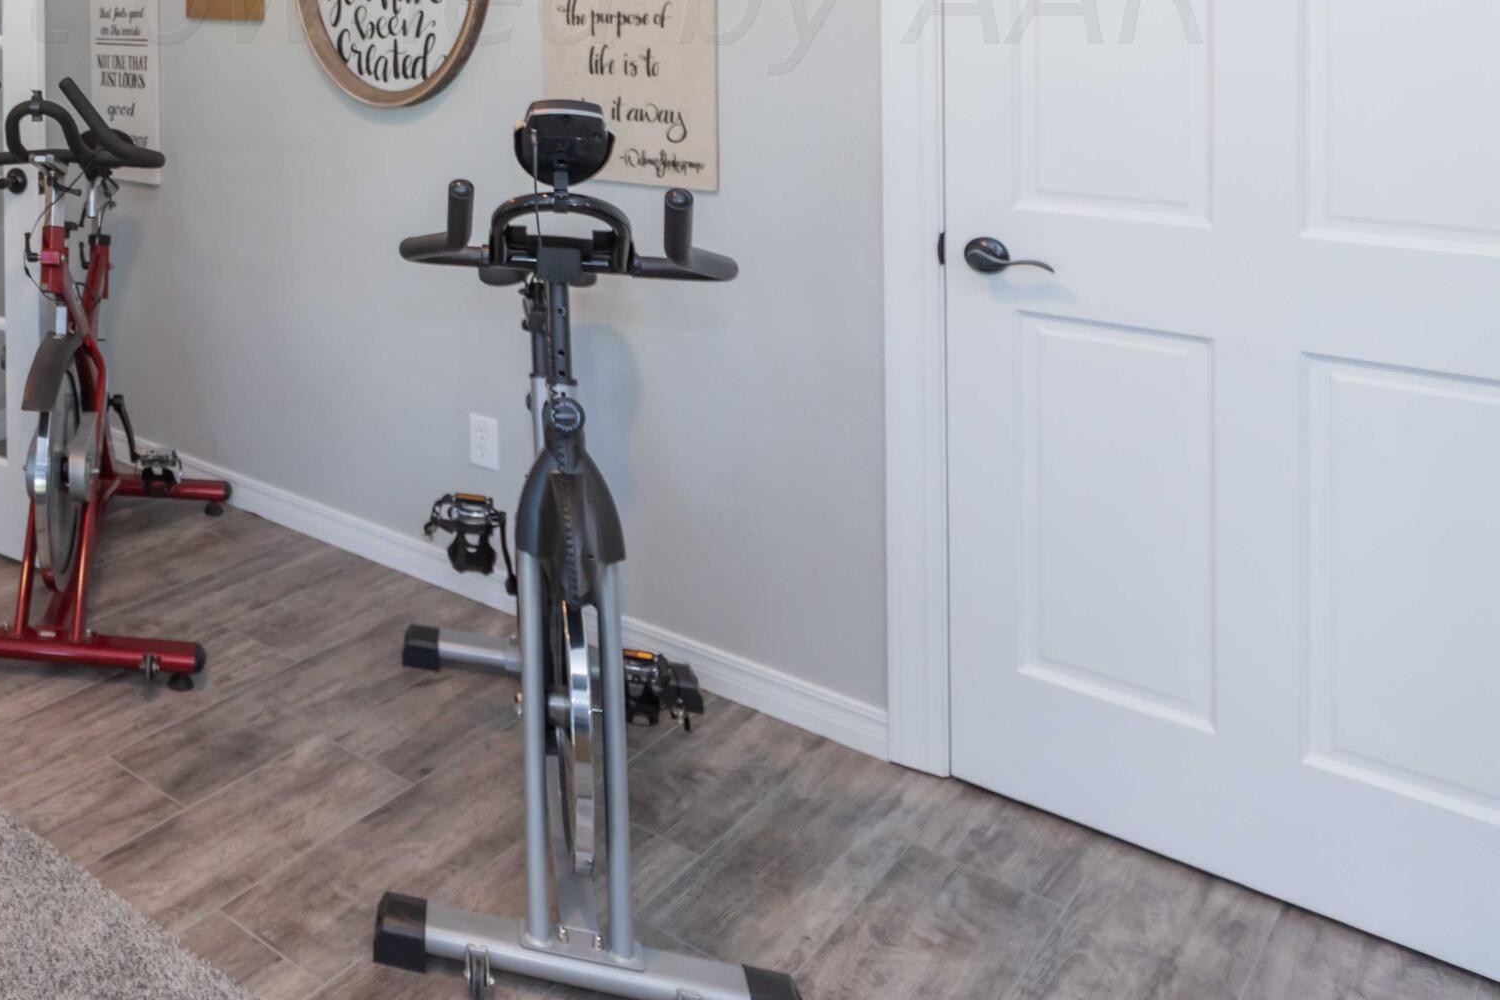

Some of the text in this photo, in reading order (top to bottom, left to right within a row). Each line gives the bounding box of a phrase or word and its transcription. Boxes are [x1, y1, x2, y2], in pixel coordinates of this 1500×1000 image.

[354, 5, 436, 41] been
[557, 0, 673, 38] the purpose of
[589, 44, 660, 77] life is to
[107, 102, 136, 122] good
[611, 96, 688, 144] it away
